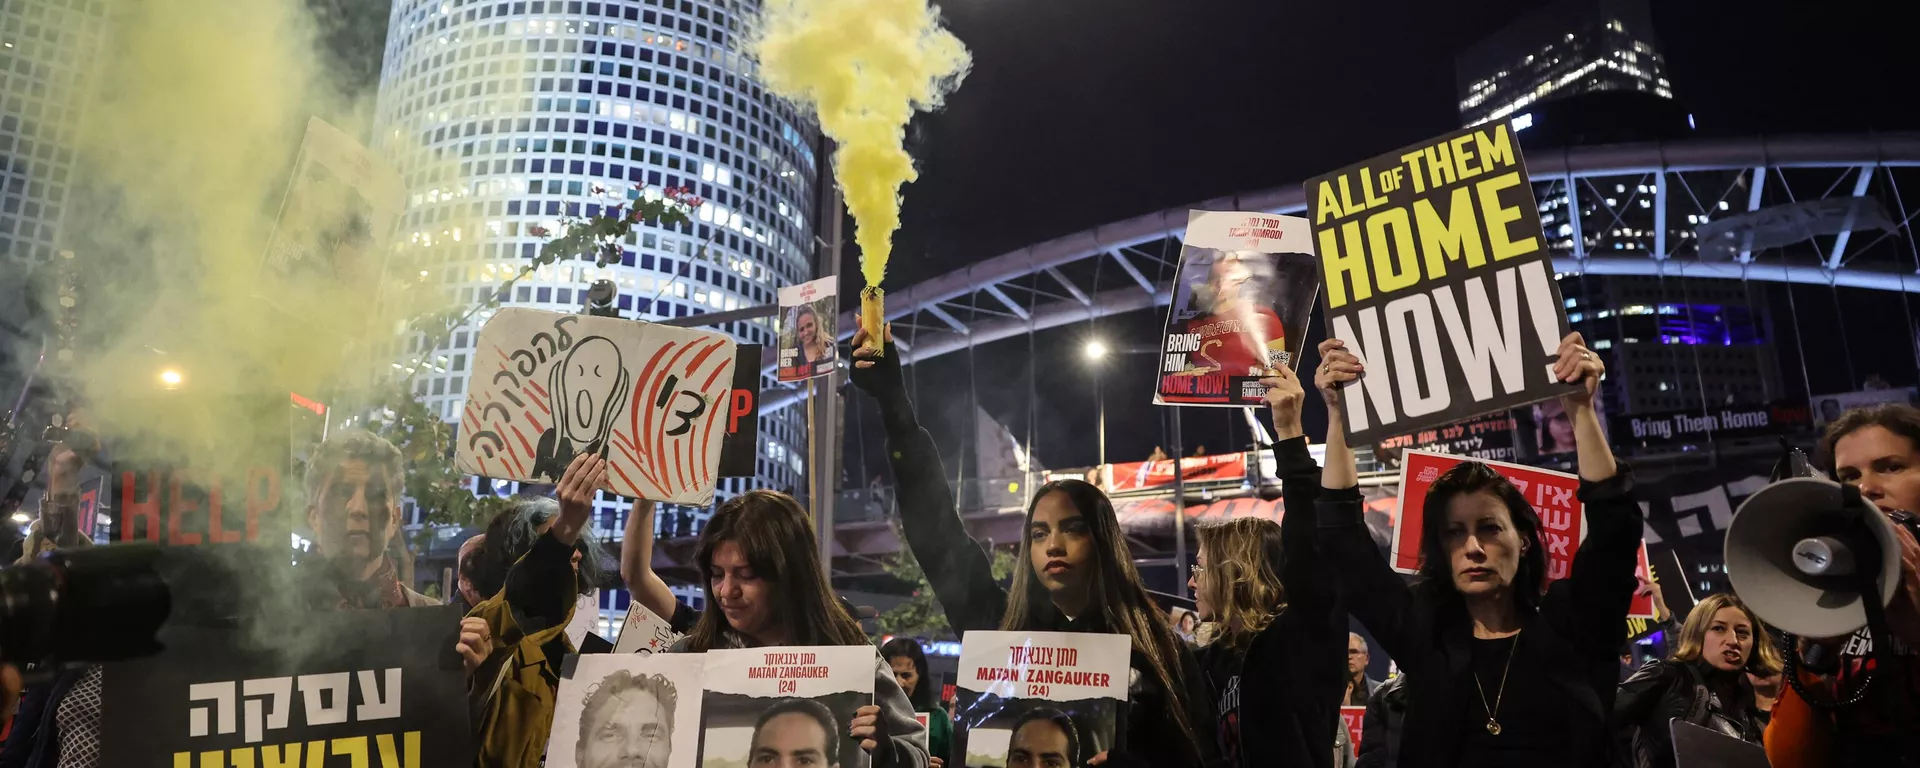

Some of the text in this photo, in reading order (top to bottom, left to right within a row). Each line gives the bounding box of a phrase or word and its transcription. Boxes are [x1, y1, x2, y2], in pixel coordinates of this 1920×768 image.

[1316, 124, 1515, 225] ALL OF THEM
[1251, 228, 1283, 240] NIMRODI
[1318, 171, 1539, 309] HOME
[1166, 333, 1201, 352] BRING
[1332, 260, 1561, 433] NOW!
[1164, 353, 1186, 372] HIM
[1161, 373, 1230, 395] HOME NOW!
[1631, 417, 1672, 438] Bring
[1674, 414, 1718, 434] Them
[1722, 408, 1768, 429] Home
[121, 465, 281, 546] HELP
[1536, 483, 1573, 508] אין
[764, 653, 816, 666] מתן צנגאוקר
[1010, 646, 1078, 667] מתן צנגאוקר
[748, 666, 829, 679] MATAN ZANGAUKER
[976, 667, 1110, 687] MATAN ZANGAUKER
[778, 680, 796, 694] (24)
[1027, 685, 1050, 697] (24)
[189, 668, 402, 743] עסקה
